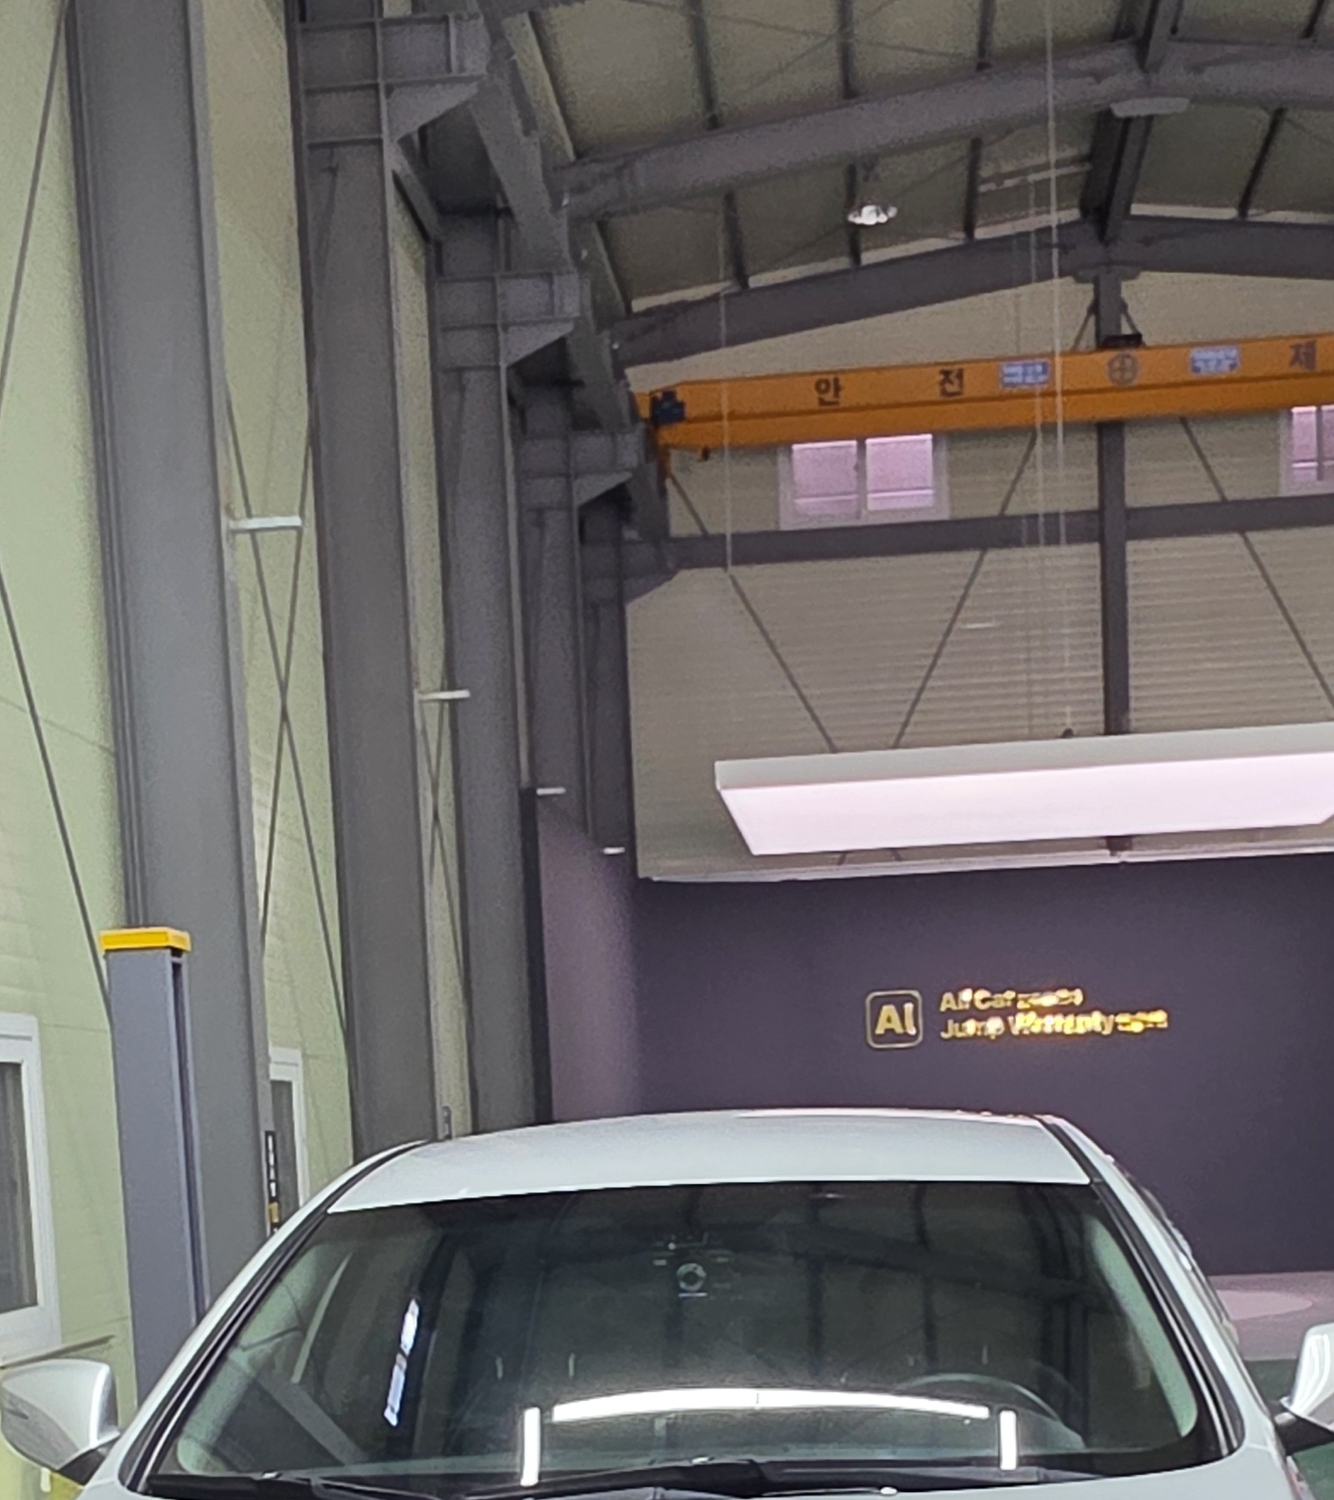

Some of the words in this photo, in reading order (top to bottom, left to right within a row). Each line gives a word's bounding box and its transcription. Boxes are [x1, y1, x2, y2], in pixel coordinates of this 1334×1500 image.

[814, 376, 843, 406] 안
[938, 367, 965, 398] 전
[1288, 340, 1318, 372] 제
